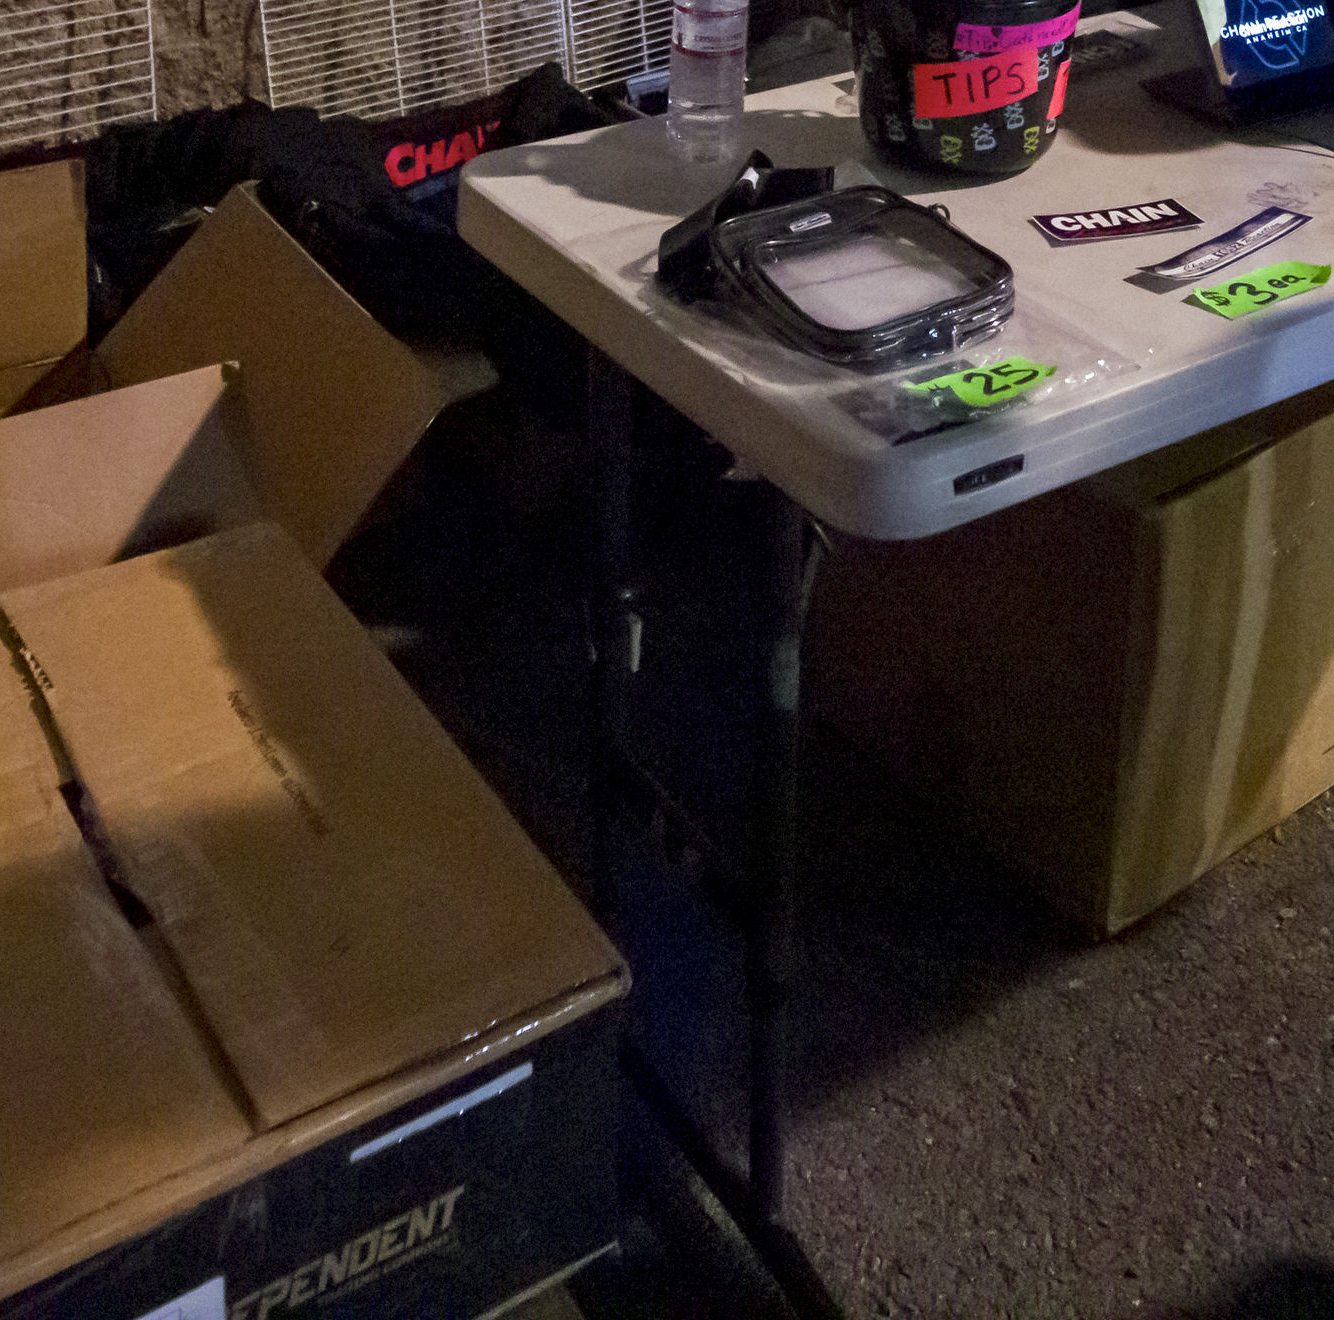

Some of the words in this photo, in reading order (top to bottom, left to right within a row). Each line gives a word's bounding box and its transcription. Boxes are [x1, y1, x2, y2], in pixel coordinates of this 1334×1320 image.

[1246, 28, 1292, 45] ANAHEIM
[1296, 24, 1308, 33] CA
[932, 62, 1025, 105] TIPS
[1050, 203, 1179, 232] CHAIN
